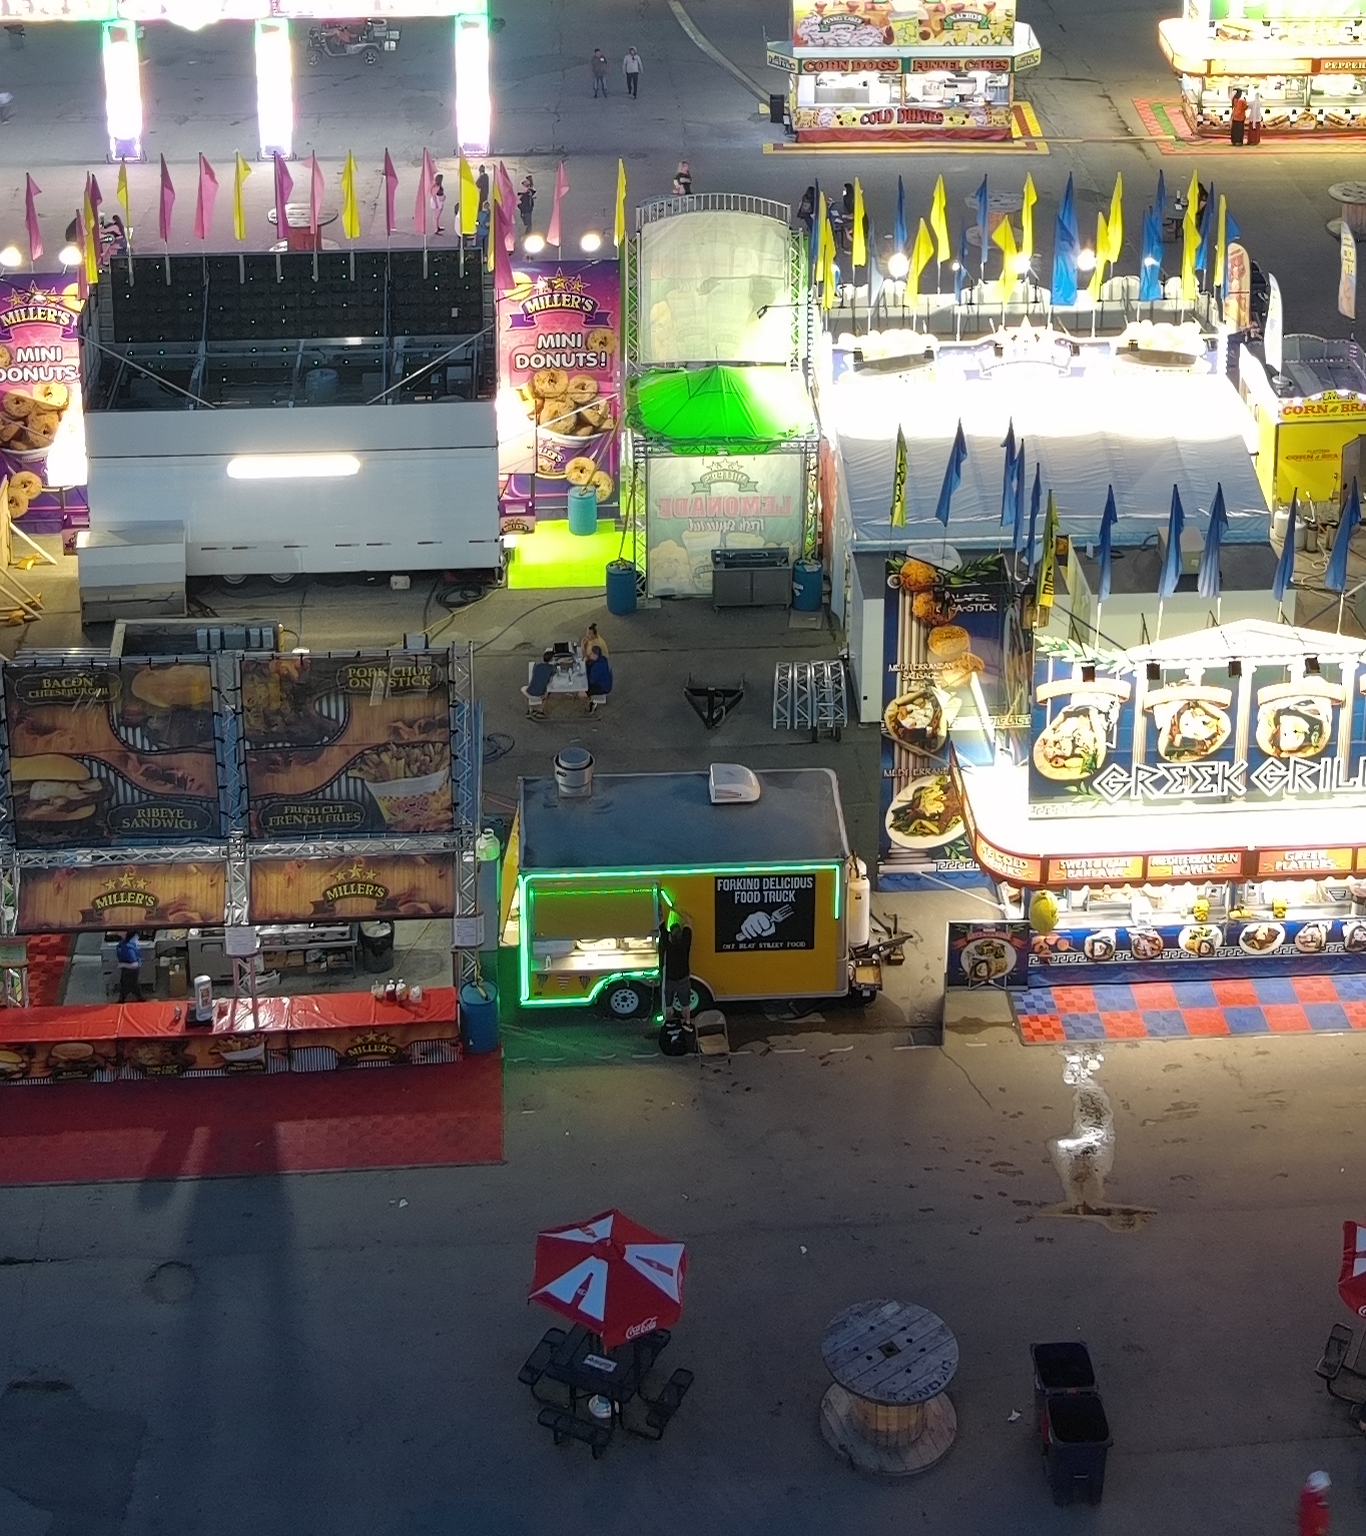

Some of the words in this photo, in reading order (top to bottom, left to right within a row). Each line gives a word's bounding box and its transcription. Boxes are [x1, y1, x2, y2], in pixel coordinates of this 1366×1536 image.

[803, 60, 849, 71] CORN
[852, 59, 899, 71] DOGS
[913, 60, 961, 71] FUNNEL
[965, 60, 1009, 71] CAKES
[860, 109, 893, 125] COLD
[527, 294, 594, 313] MILLER'S
[0, 307, 71, 325] MILLER'S
[537, 332, 582, 349] MINI
[16, 347, 62, 362] MINI
[515, 352, 606, 369] DONUTS!
[1282, 404, 1329, 415] CORN
[347, 666, 387, 678] PORK
[390, 664, 433, 677] CHOP
[42, 676, 94, 688] BACON
[348, 677, 373, 688] ON
[389, 674, 431, 687] STICK
[136, 807, 185, 819] RIBEYE
[283, 805, 315, 816] FRESH
[317, 804, 346, 815] CUT
[121, 816, 199, 830] SANDWICH
[268, 813, 316, 827] FRENCH
[318, 811, 364, 824] FRIES
[762, 876, 814, 890] DELICIOUS
[325, 883, 386, 901] MILLER'S
[734, 891, 761, 904] FOOD
[763, 890, 796, 903] TRUCK
[94, 892, 155, 909] MILLER'S
[346, 1043, 397, 1057] MILLER'S
